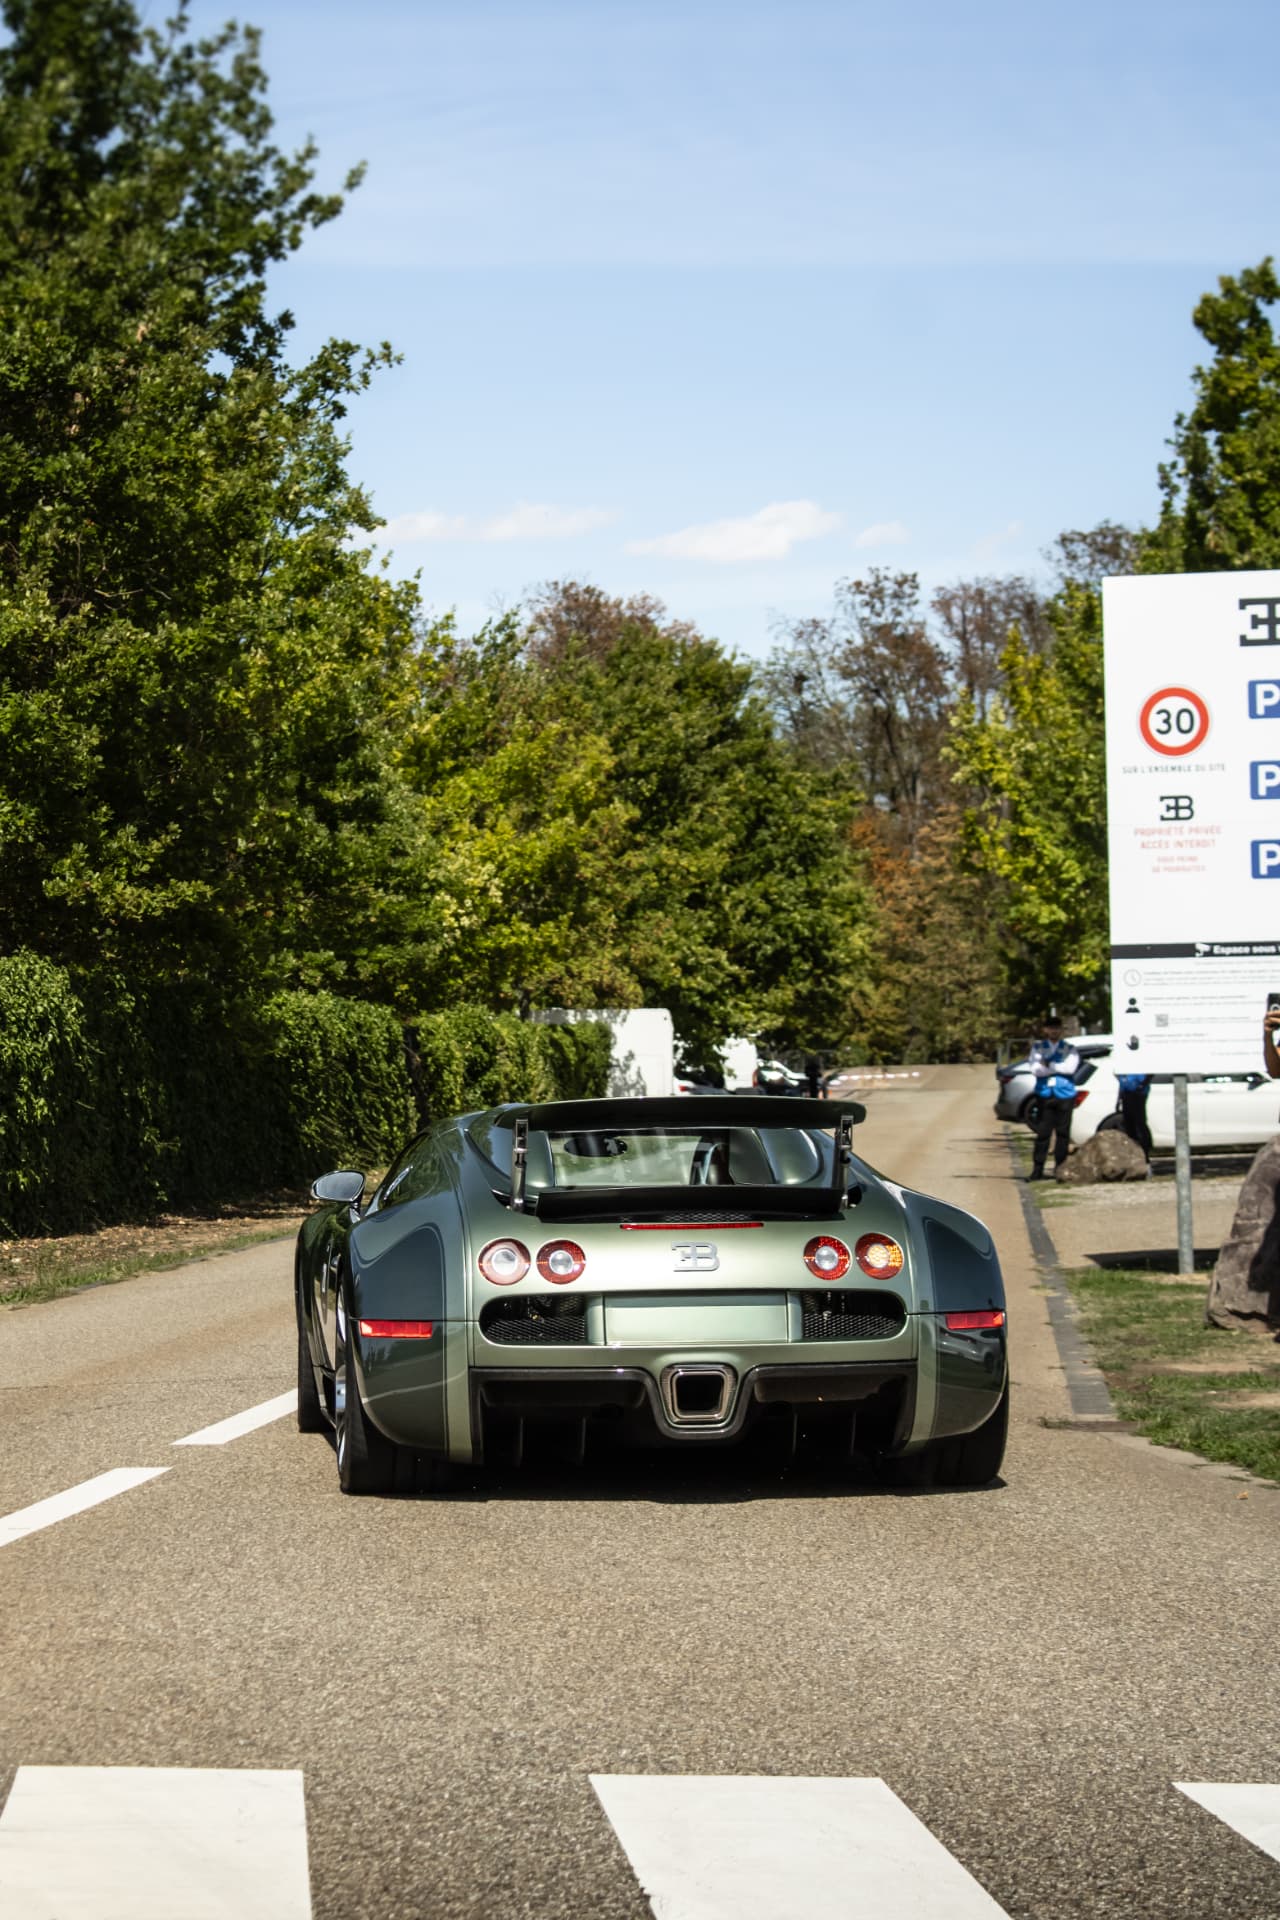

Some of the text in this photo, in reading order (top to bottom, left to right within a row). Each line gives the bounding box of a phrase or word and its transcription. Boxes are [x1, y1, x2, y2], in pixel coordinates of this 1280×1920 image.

[1255, 683, 1280, 716] P
[1156, 708, 1194, 735] 30
[1122, 765, 1138, 774] SUR
[1208, 763, 1225, 772] SITE
[1257, 764, 1280, 797] P
[1259, 842, 1280, 876] P
